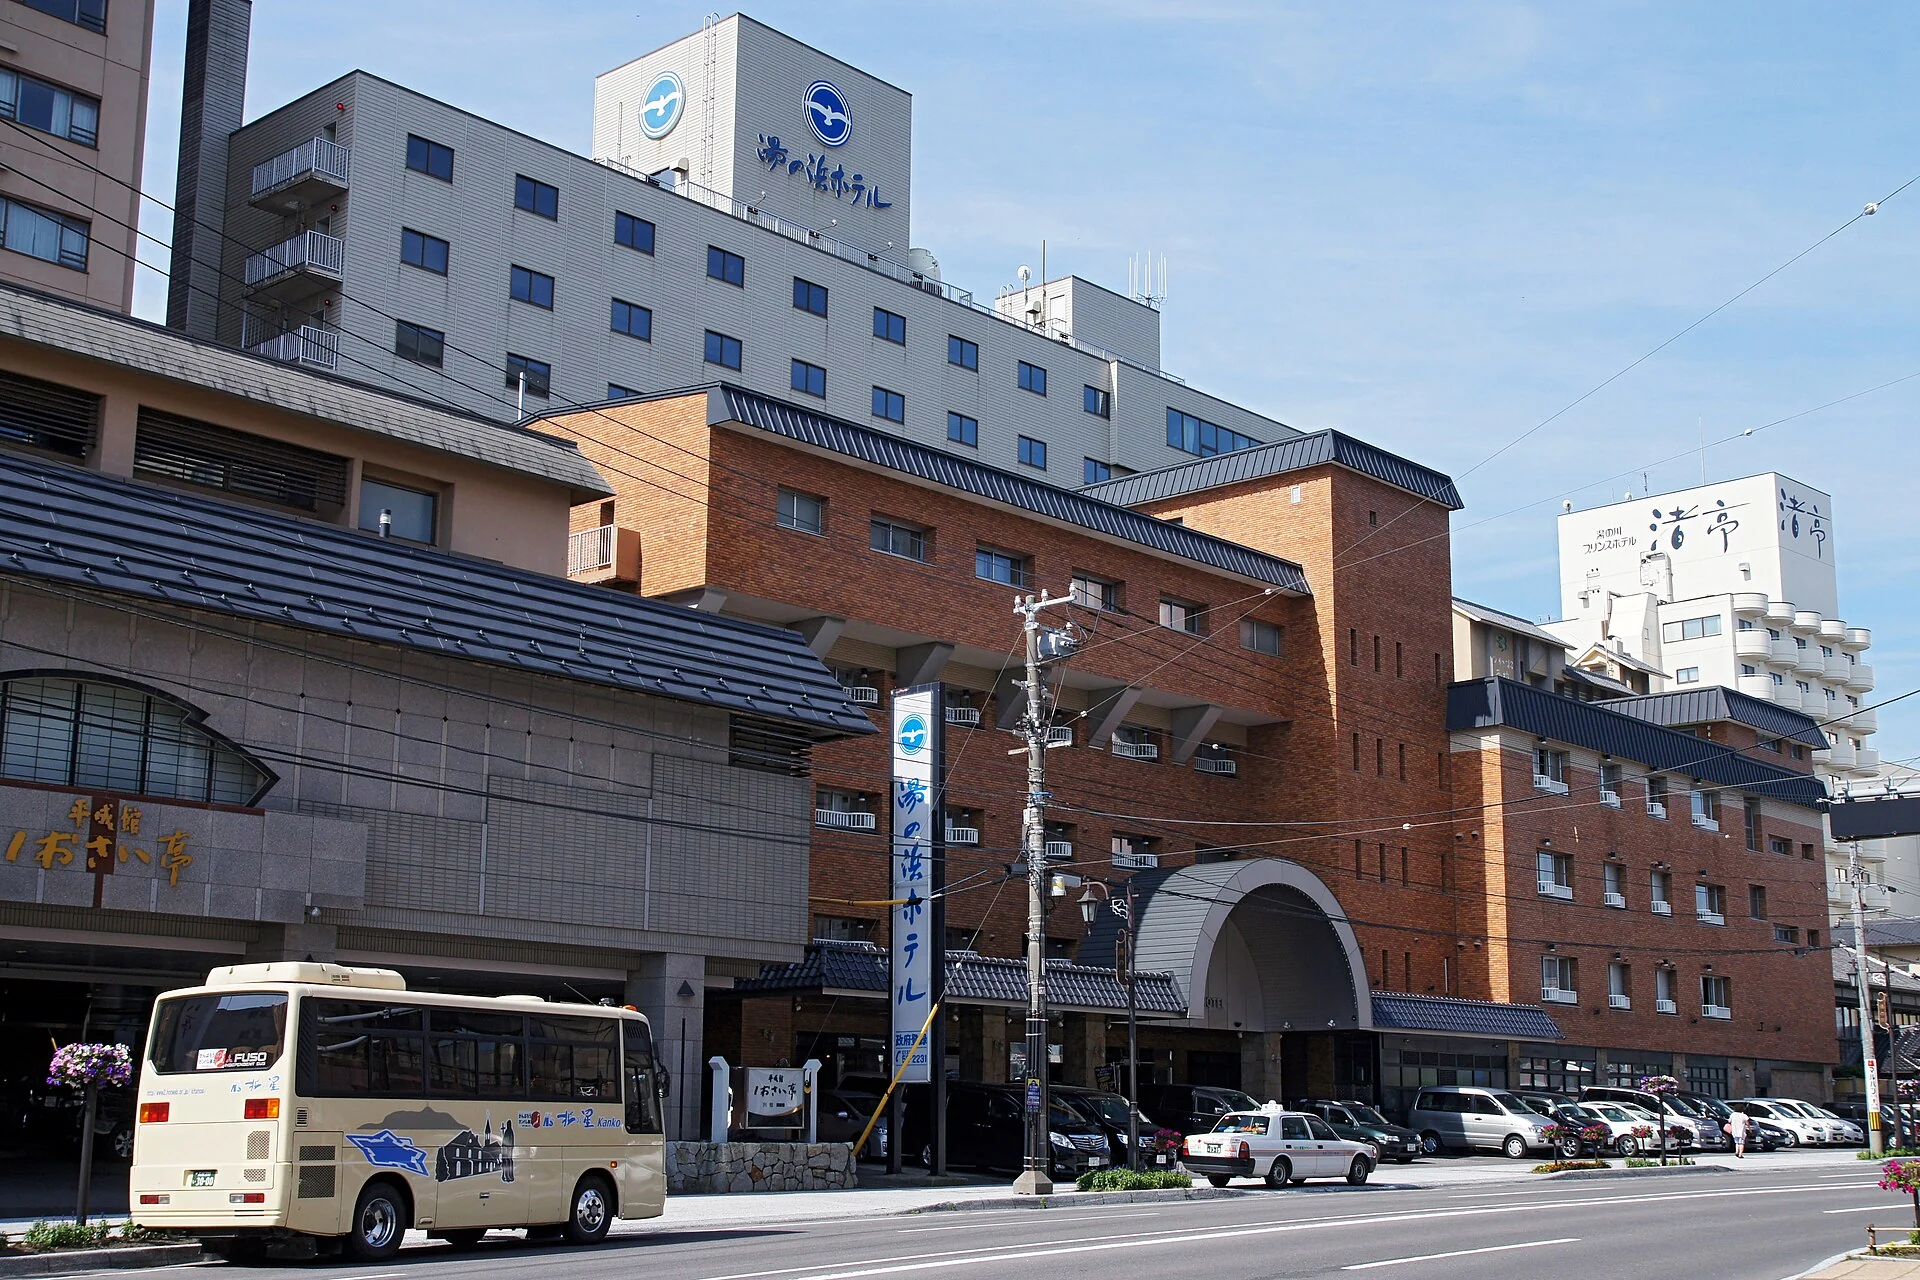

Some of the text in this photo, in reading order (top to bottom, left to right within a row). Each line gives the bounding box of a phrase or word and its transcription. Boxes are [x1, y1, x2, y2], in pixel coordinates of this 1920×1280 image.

[756, 133, 893, 209] 湯の浜ホテル
[1649, 499, 1751, 554] 渚亭
[1582, 536, 1637, 555] プリンスホテル
[68, 799, 143, 835] 平成館
[897, 777, 928, 1006] 湯の浜ホテル
[233, 1052, 267, 1063] FUSO
[597, 1117, 621, 1128] Kanko
